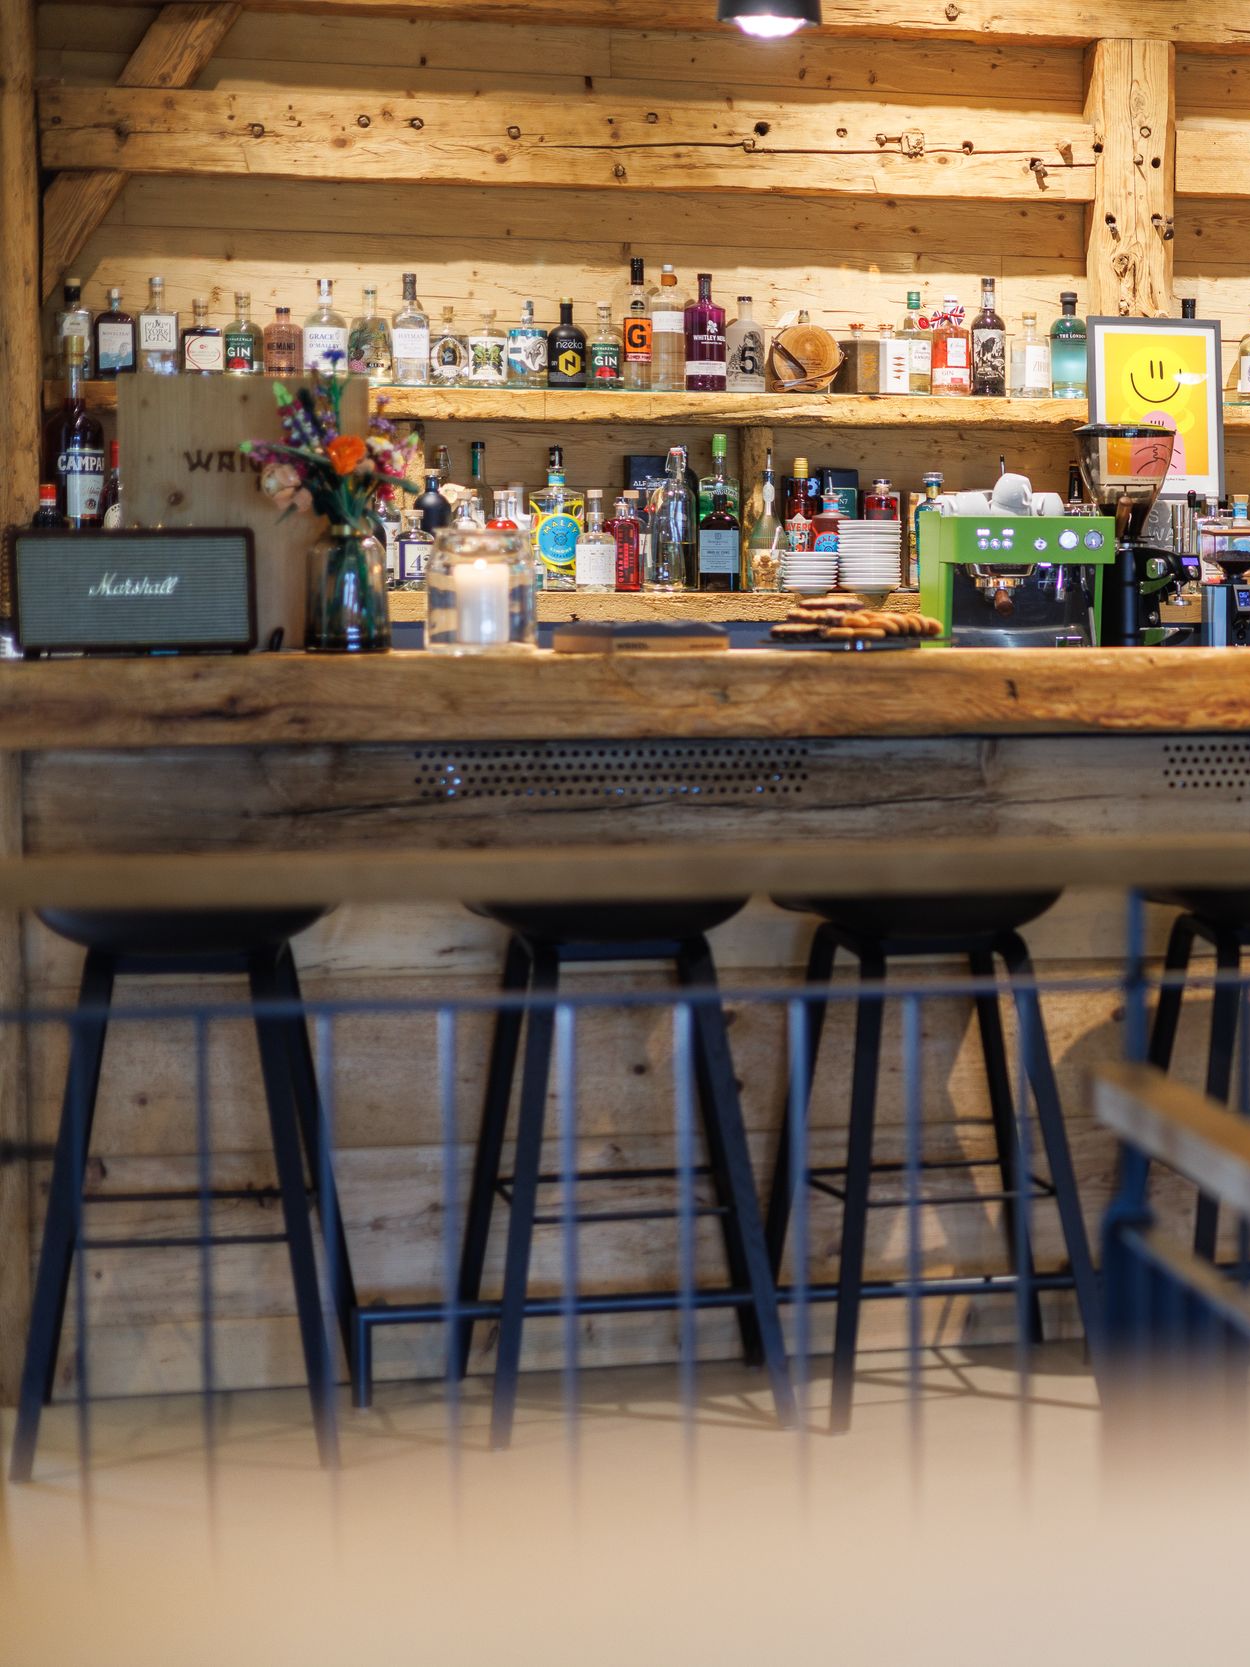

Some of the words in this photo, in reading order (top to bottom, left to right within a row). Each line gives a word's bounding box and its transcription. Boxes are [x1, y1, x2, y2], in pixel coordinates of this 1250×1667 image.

[628, 324, 646, 348] G
[556, 339, 583, 349] neeka
[227, 346, 250, 357] GIN
[594, 355, 617, 366] GIN
[543, 519, 577, 535] MALFY
[88, 572, 178, 596] Marshall
